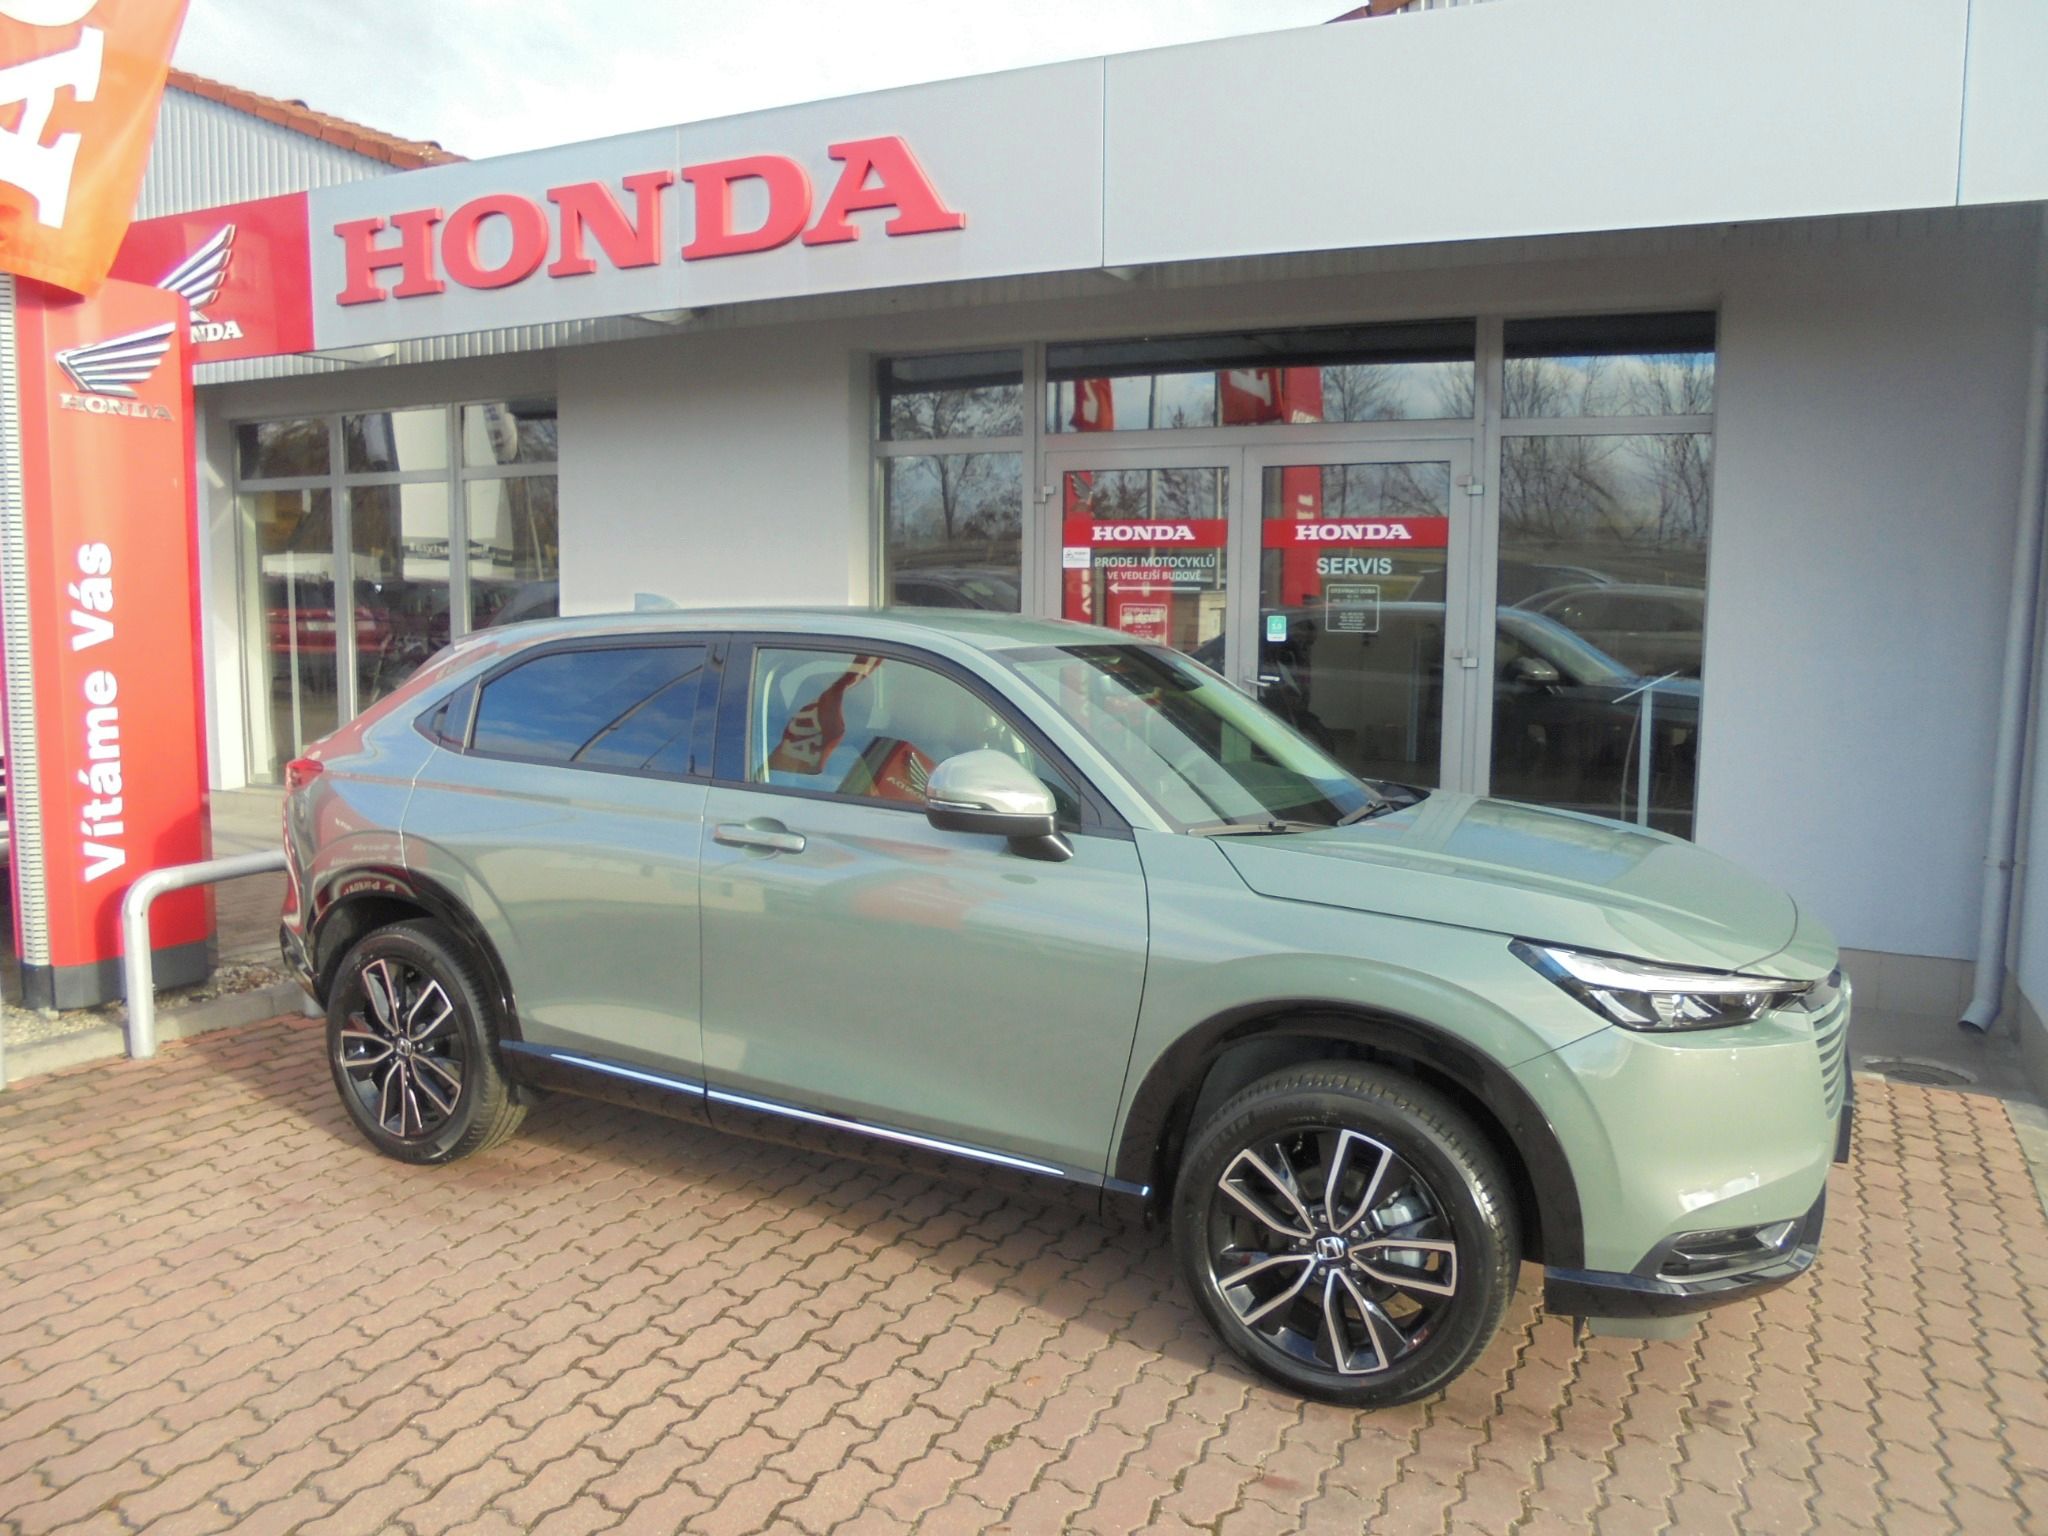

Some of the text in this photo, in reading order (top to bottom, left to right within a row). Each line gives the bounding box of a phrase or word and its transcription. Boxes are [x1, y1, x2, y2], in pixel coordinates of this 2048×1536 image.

[334, 136, 965, 306] HONDA
[190, 320, 244, 343] NDA
[59, 393, 175, 421] HONDA
[1092, 525, 1196, 541] HONDA
[1294, 524, 1412, 540] HONDA
[1094, 556, 1138, 568] PRODEJ
[1316, 557, 1393, 575] SERVIS
[1107, 571, 1119, 580] VE
[68, 542, 127, 882] Vítáme Vás
